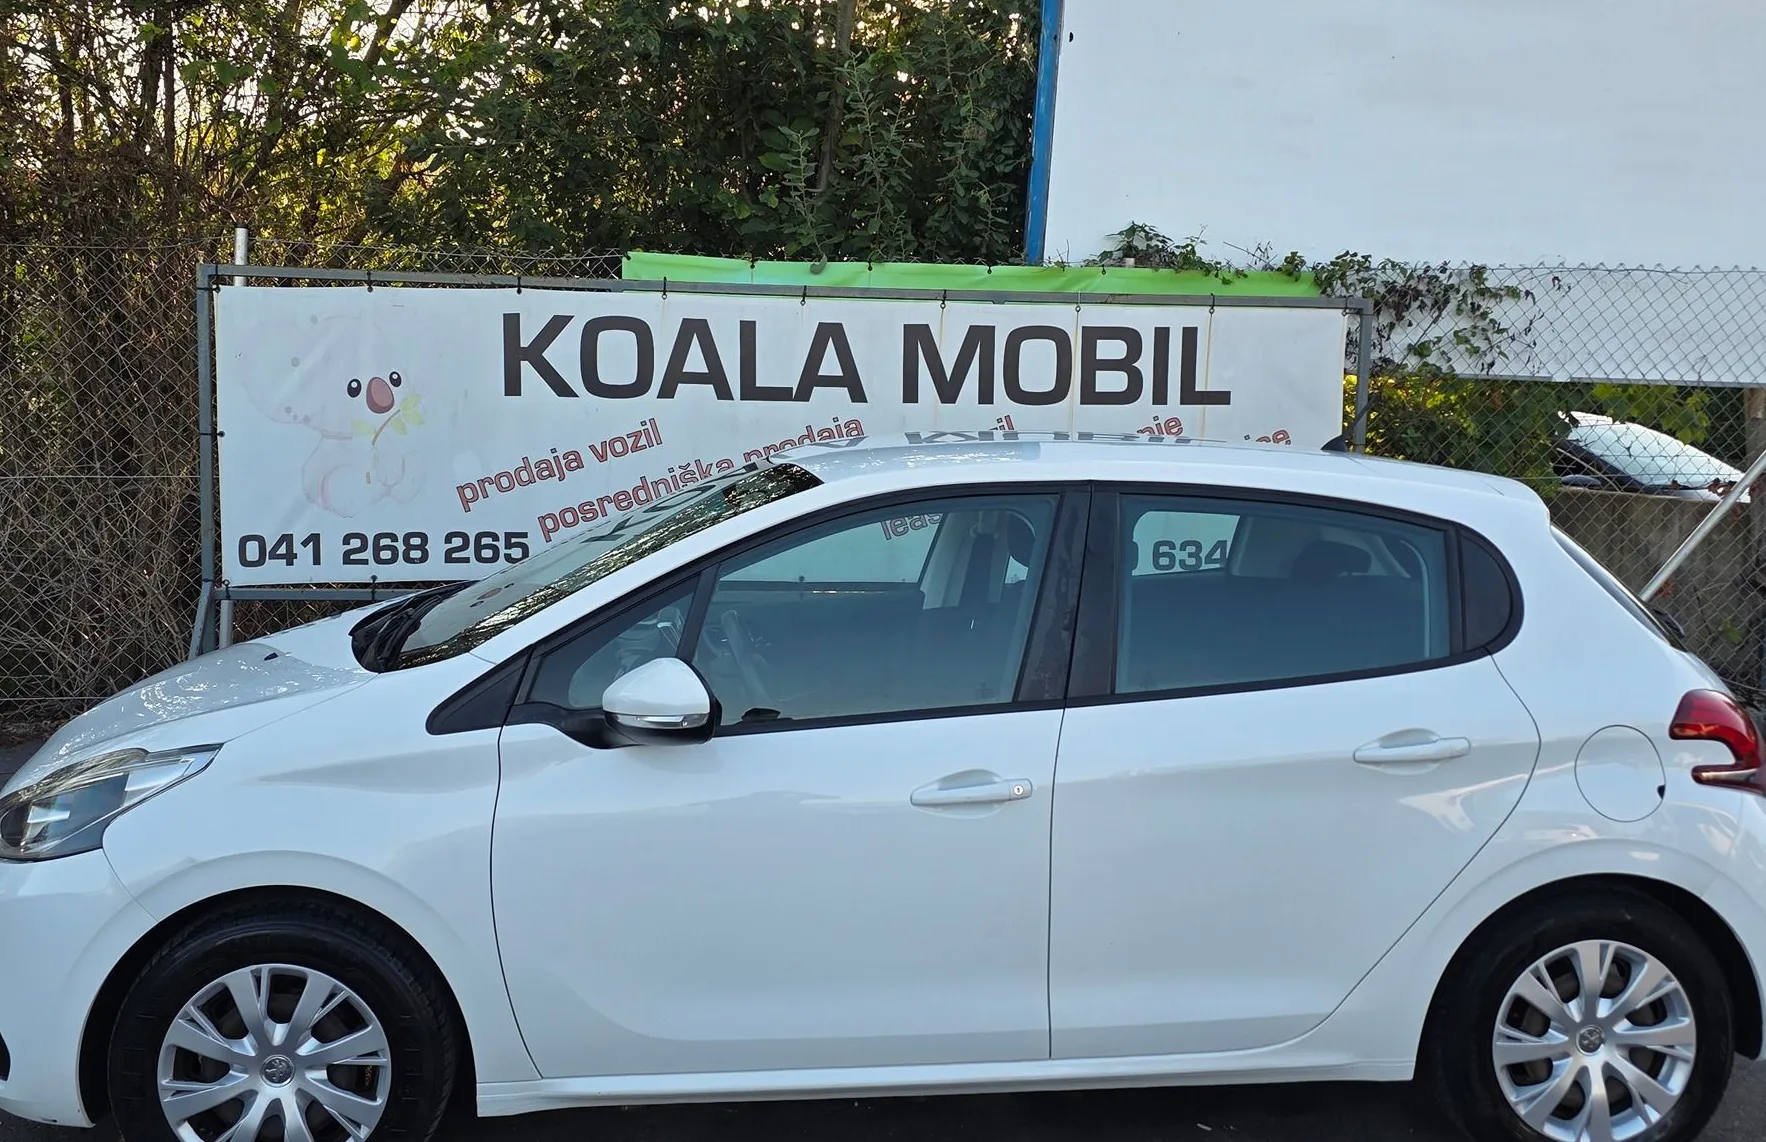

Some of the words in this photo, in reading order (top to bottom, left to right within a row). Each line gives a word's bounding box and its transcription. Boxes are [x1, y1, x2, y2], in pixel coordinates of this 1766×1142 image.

[502, 312, 869, 404] KOALA
[902, 323, 1232, 406] MOBIL
[456, 447, 585, 513] prodaja
[588, 417, 663, 463] vozil
[537, 457, 735, 543] posredniška
[238, 533, 322, 568] 041
[342, 532, 429, 565] 268
[444, 531, 530, 564] 265
[1152, 539, 1228, 571] 634
